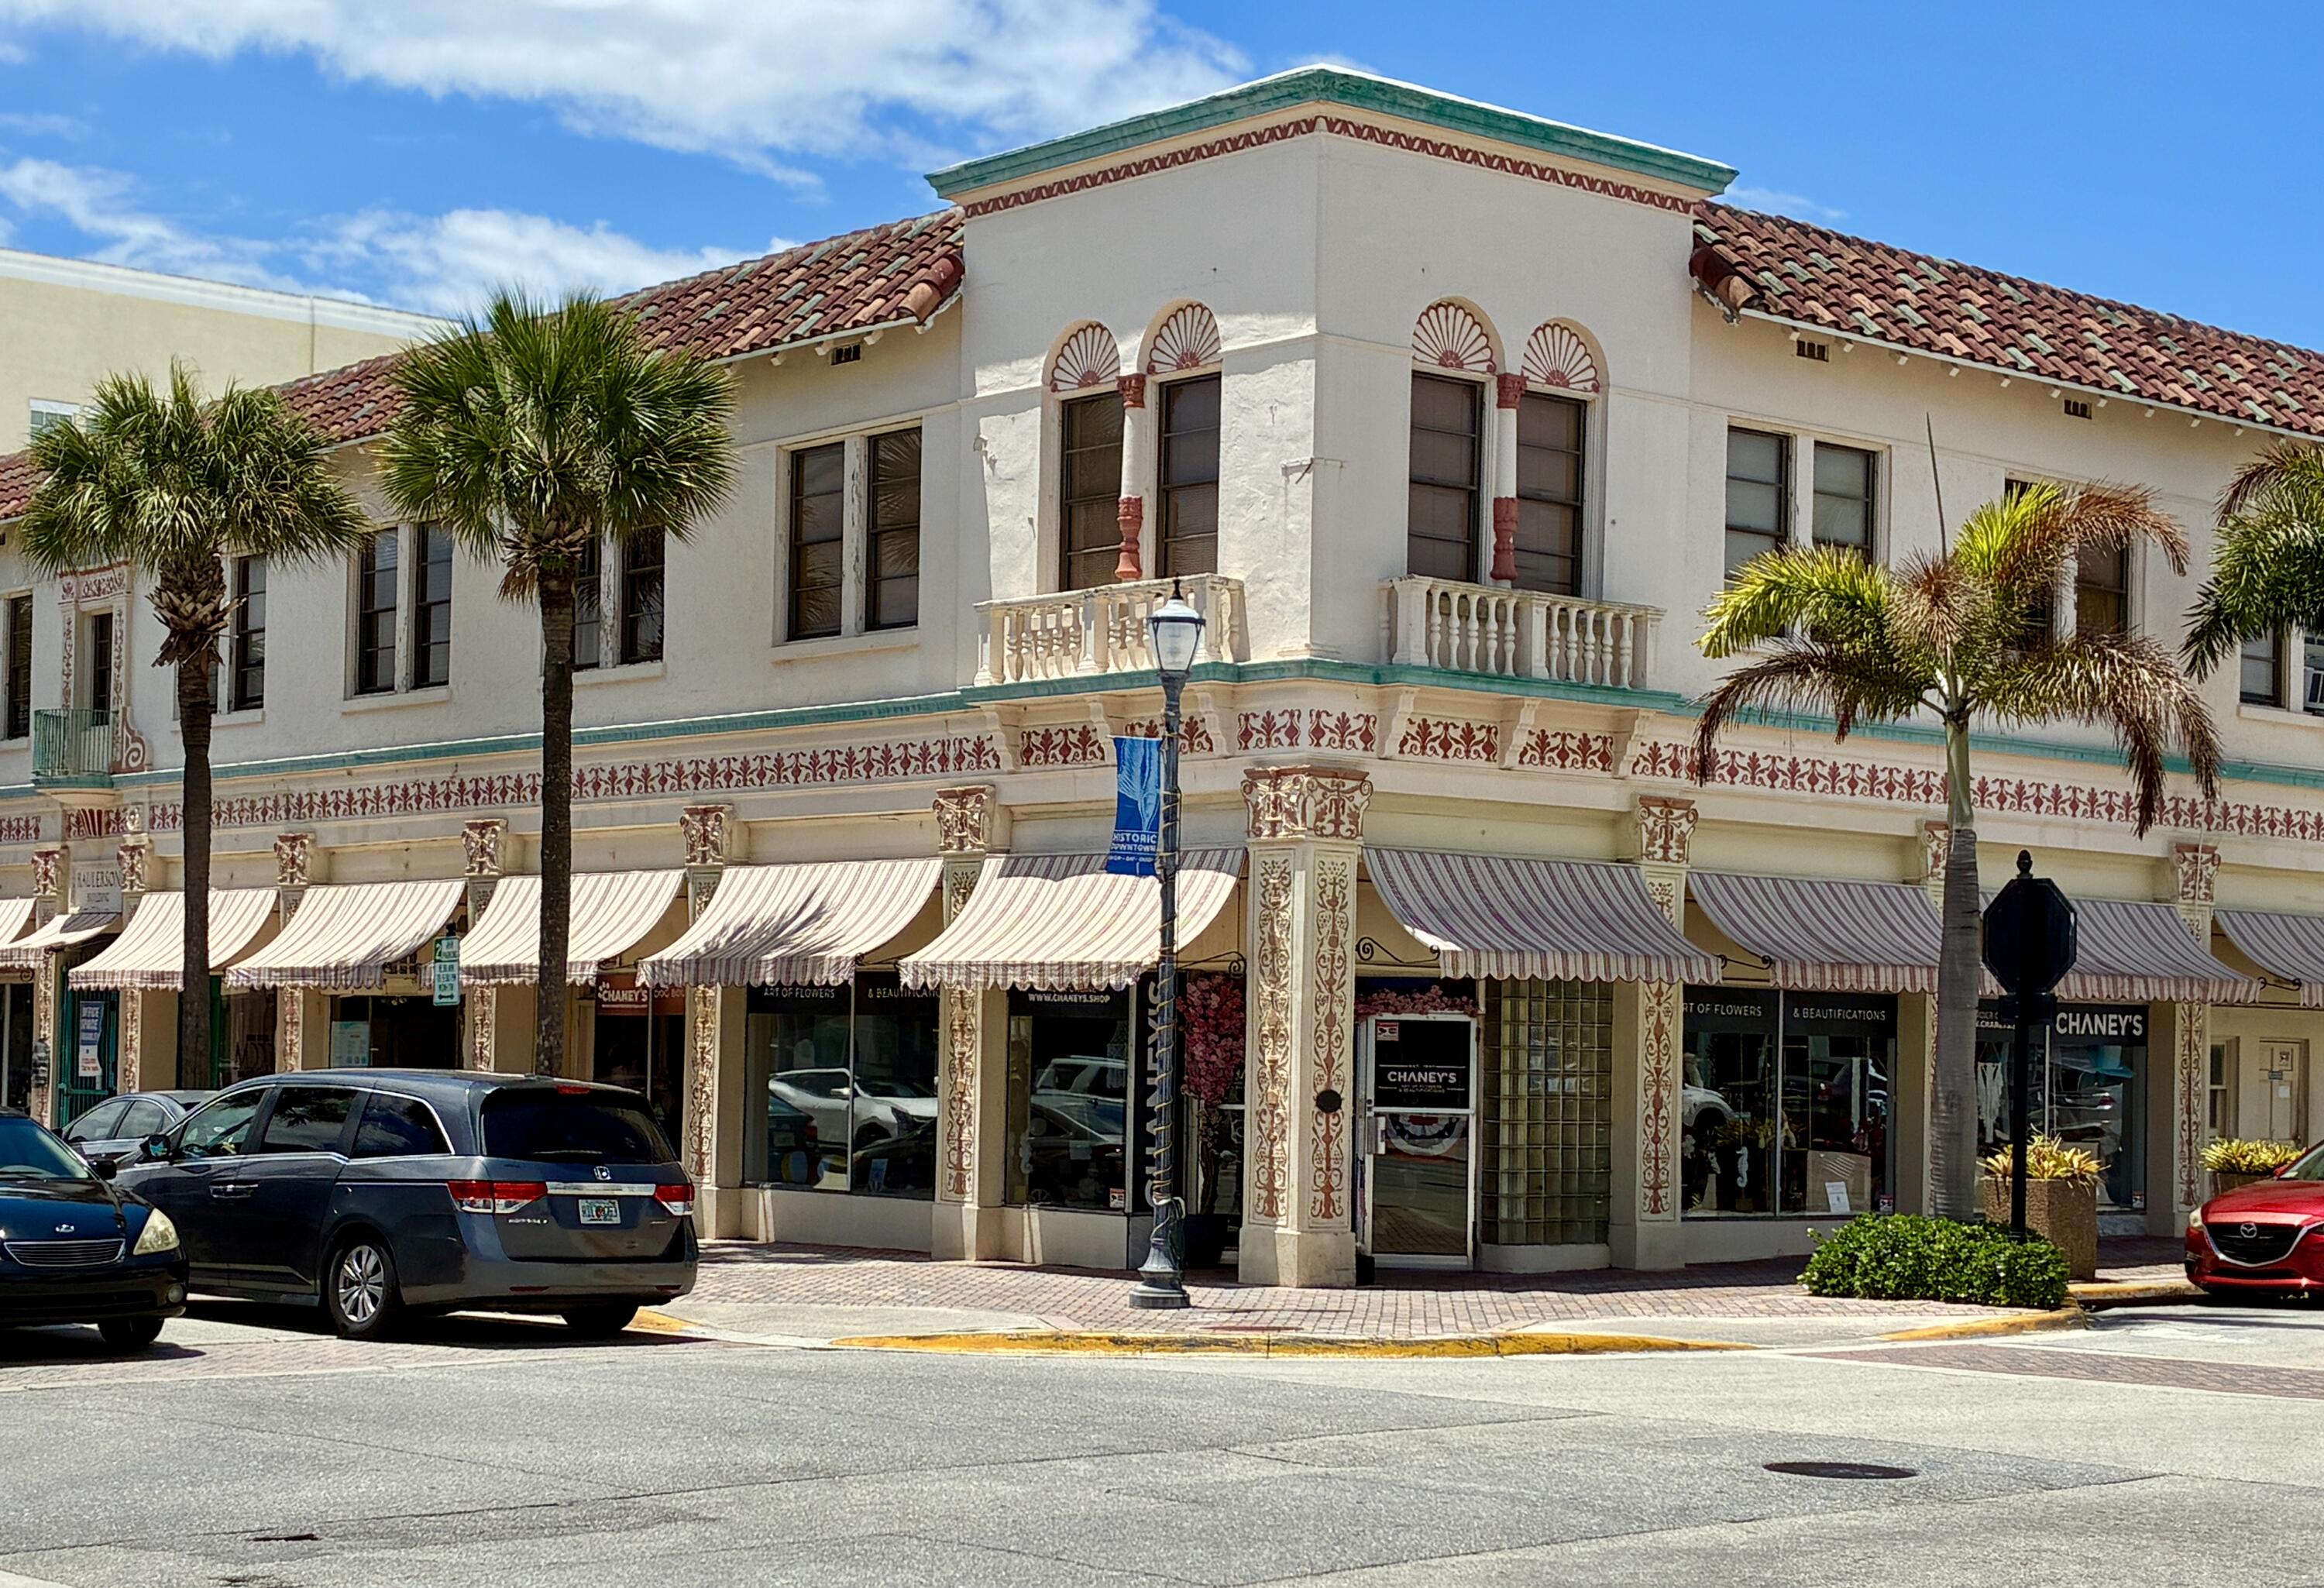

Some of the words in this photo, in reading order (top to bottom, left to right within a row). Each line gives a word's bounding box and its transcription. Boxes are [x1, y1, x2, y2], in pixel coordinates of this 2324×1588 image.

[1112, 833, 1157, 844] HISTORIC
[1111, 843, 1156, 852] DOWNTOWN
[435, 943, 442, 960] 2
[602, 989, 648, 1002] CHANEY'S
[764, 988, 779, 998] ART
[781, 988, 794, 998] OF
[795, 988, 835, 999] FLOWERS
[868, 988, 874, 999] &
[1683, 1002, 1695, 1013] RT
[1697, 1003, 1711, 1014] OF
[1714, 1004, 1762, 1017] FLOWERS
[1793, 1008, 1800, 1019] &
[1803, 1008, 1886, 1021] BEAUTIFICATIONS
[2056, 1012, 2143, 1036] CHANEY'S
[1387, 1071, 1457, 1084] CHANEY'S
